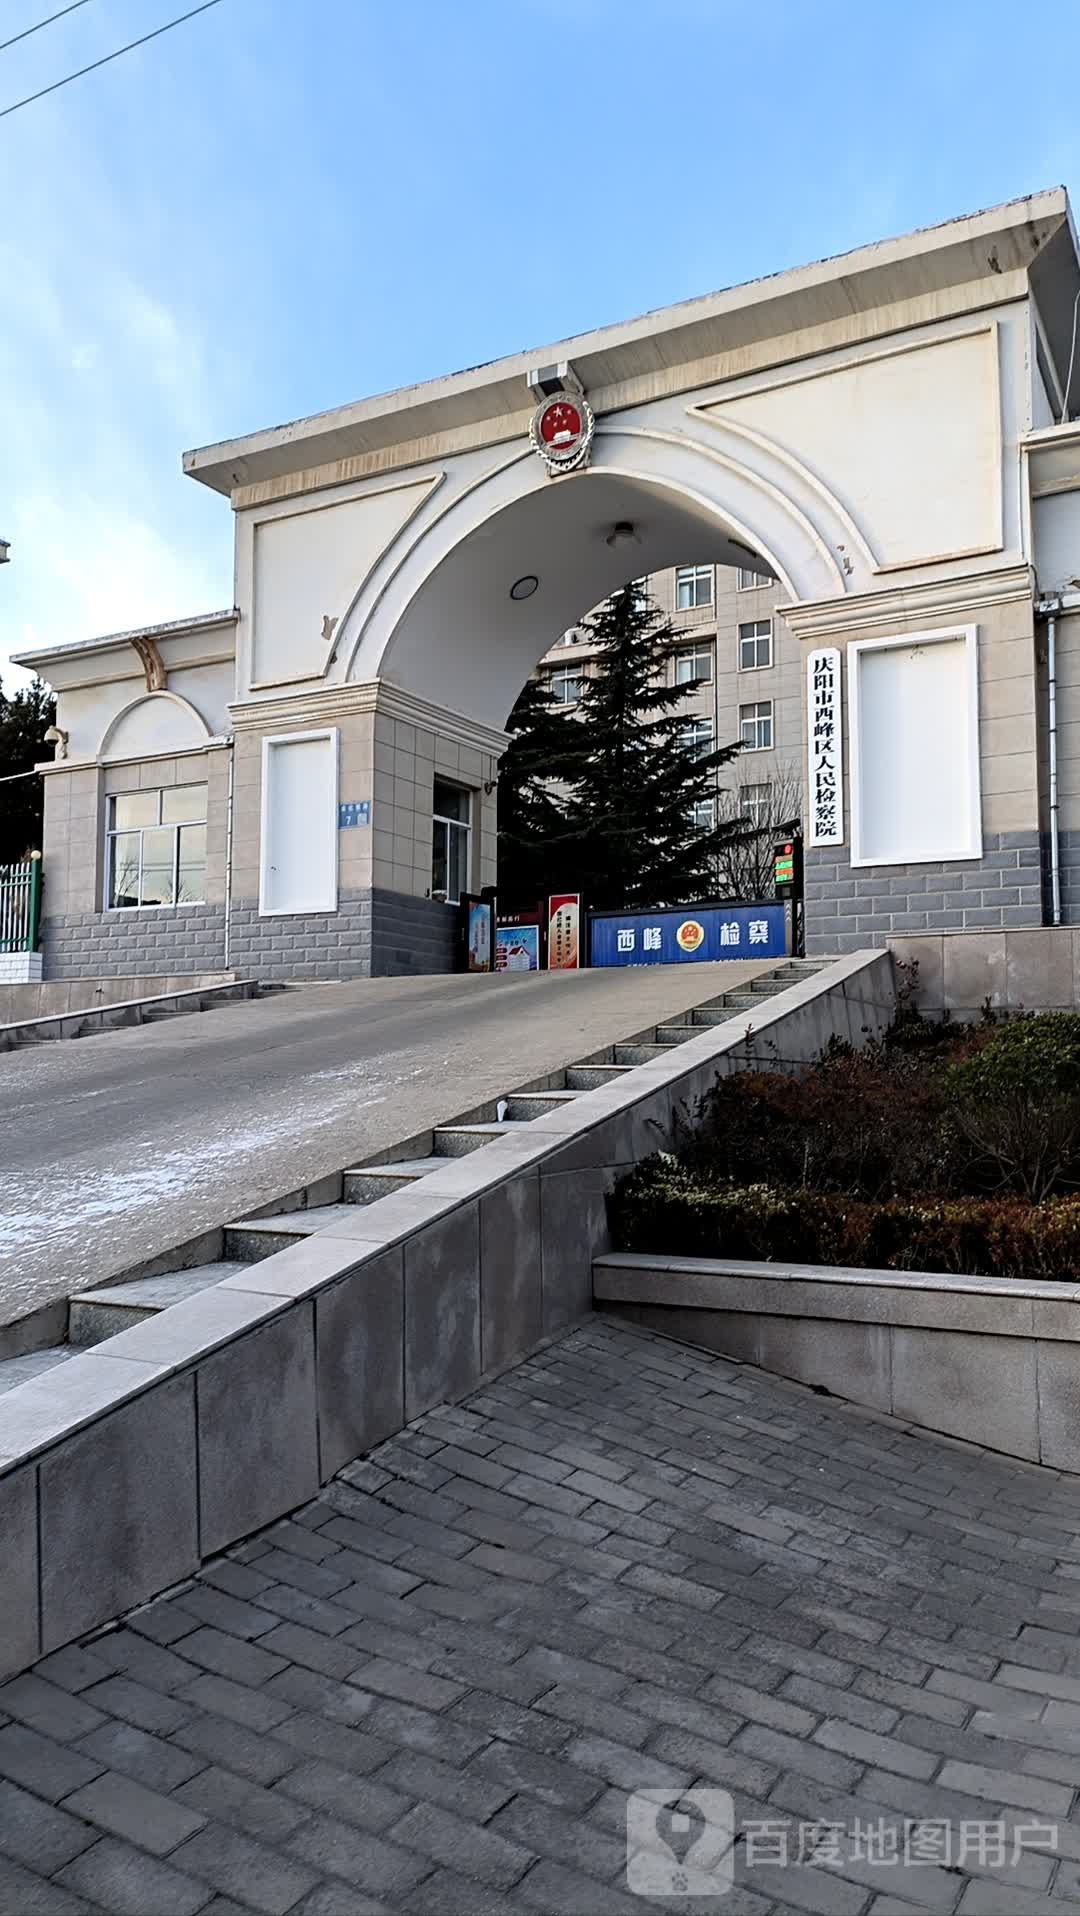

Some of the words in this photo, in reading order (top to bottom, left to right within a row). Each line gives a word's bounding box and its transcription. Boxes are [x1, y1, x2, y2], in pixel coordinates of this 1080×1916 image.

[813, 656, 837, 837] 庆阳市西峰区人民检察院
[617, 927, 662, 952] 西峰
[720, 919, 769, 946] 检察
